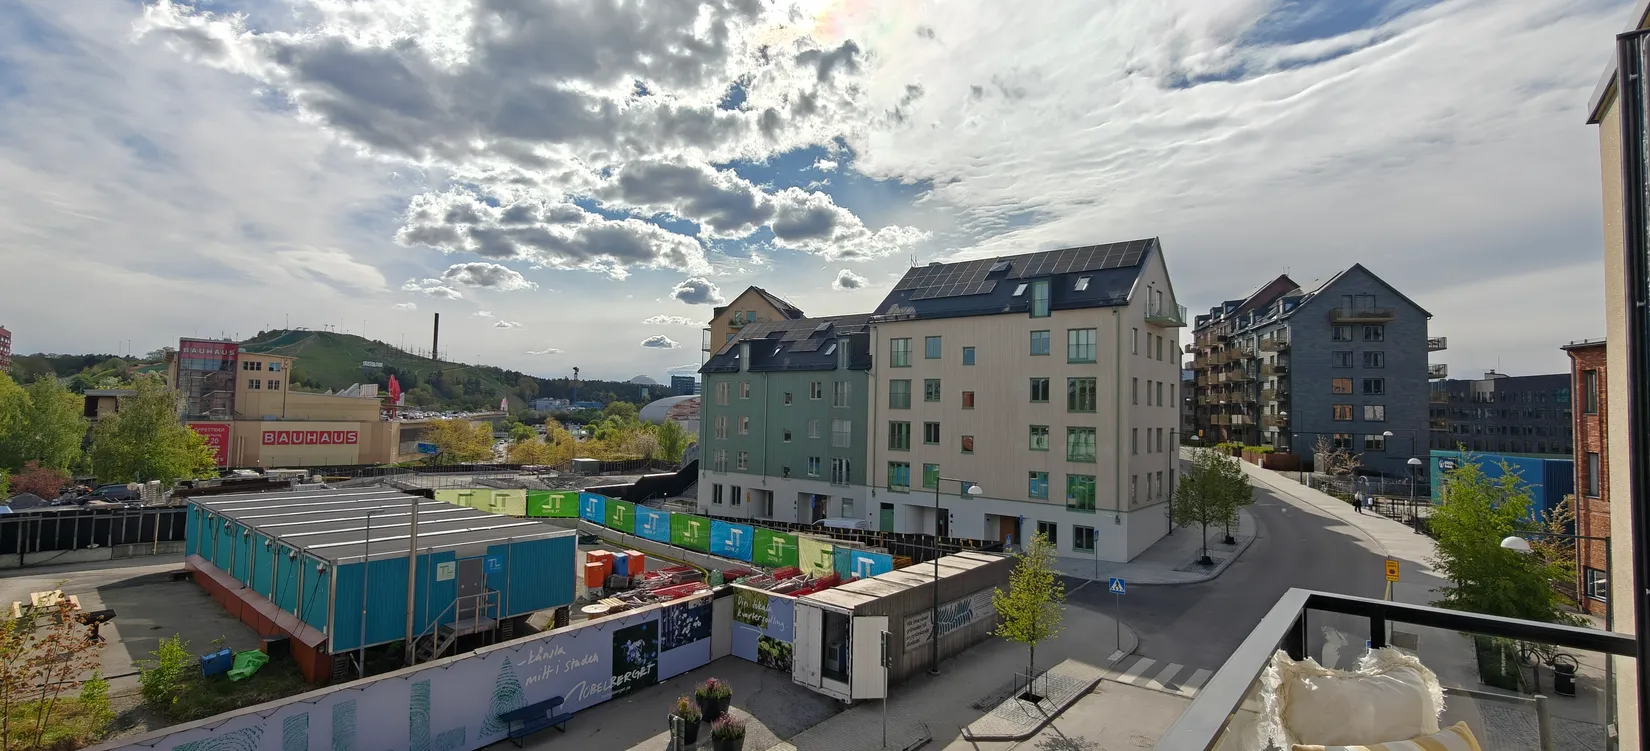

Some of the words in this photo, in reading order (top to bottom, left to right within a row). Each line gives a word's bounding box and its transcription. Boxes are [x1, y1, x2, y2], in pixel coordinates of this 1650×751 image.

[183, 346, 236, 356] BAUHAUS
[264, 432, 357, 443] BAUHAUS
[488, 558, 500, 569] TL
[440, 565, 453, 577] TL
[737, 596, 749, 609] Din
[525, 664, 554, 687] mitt
